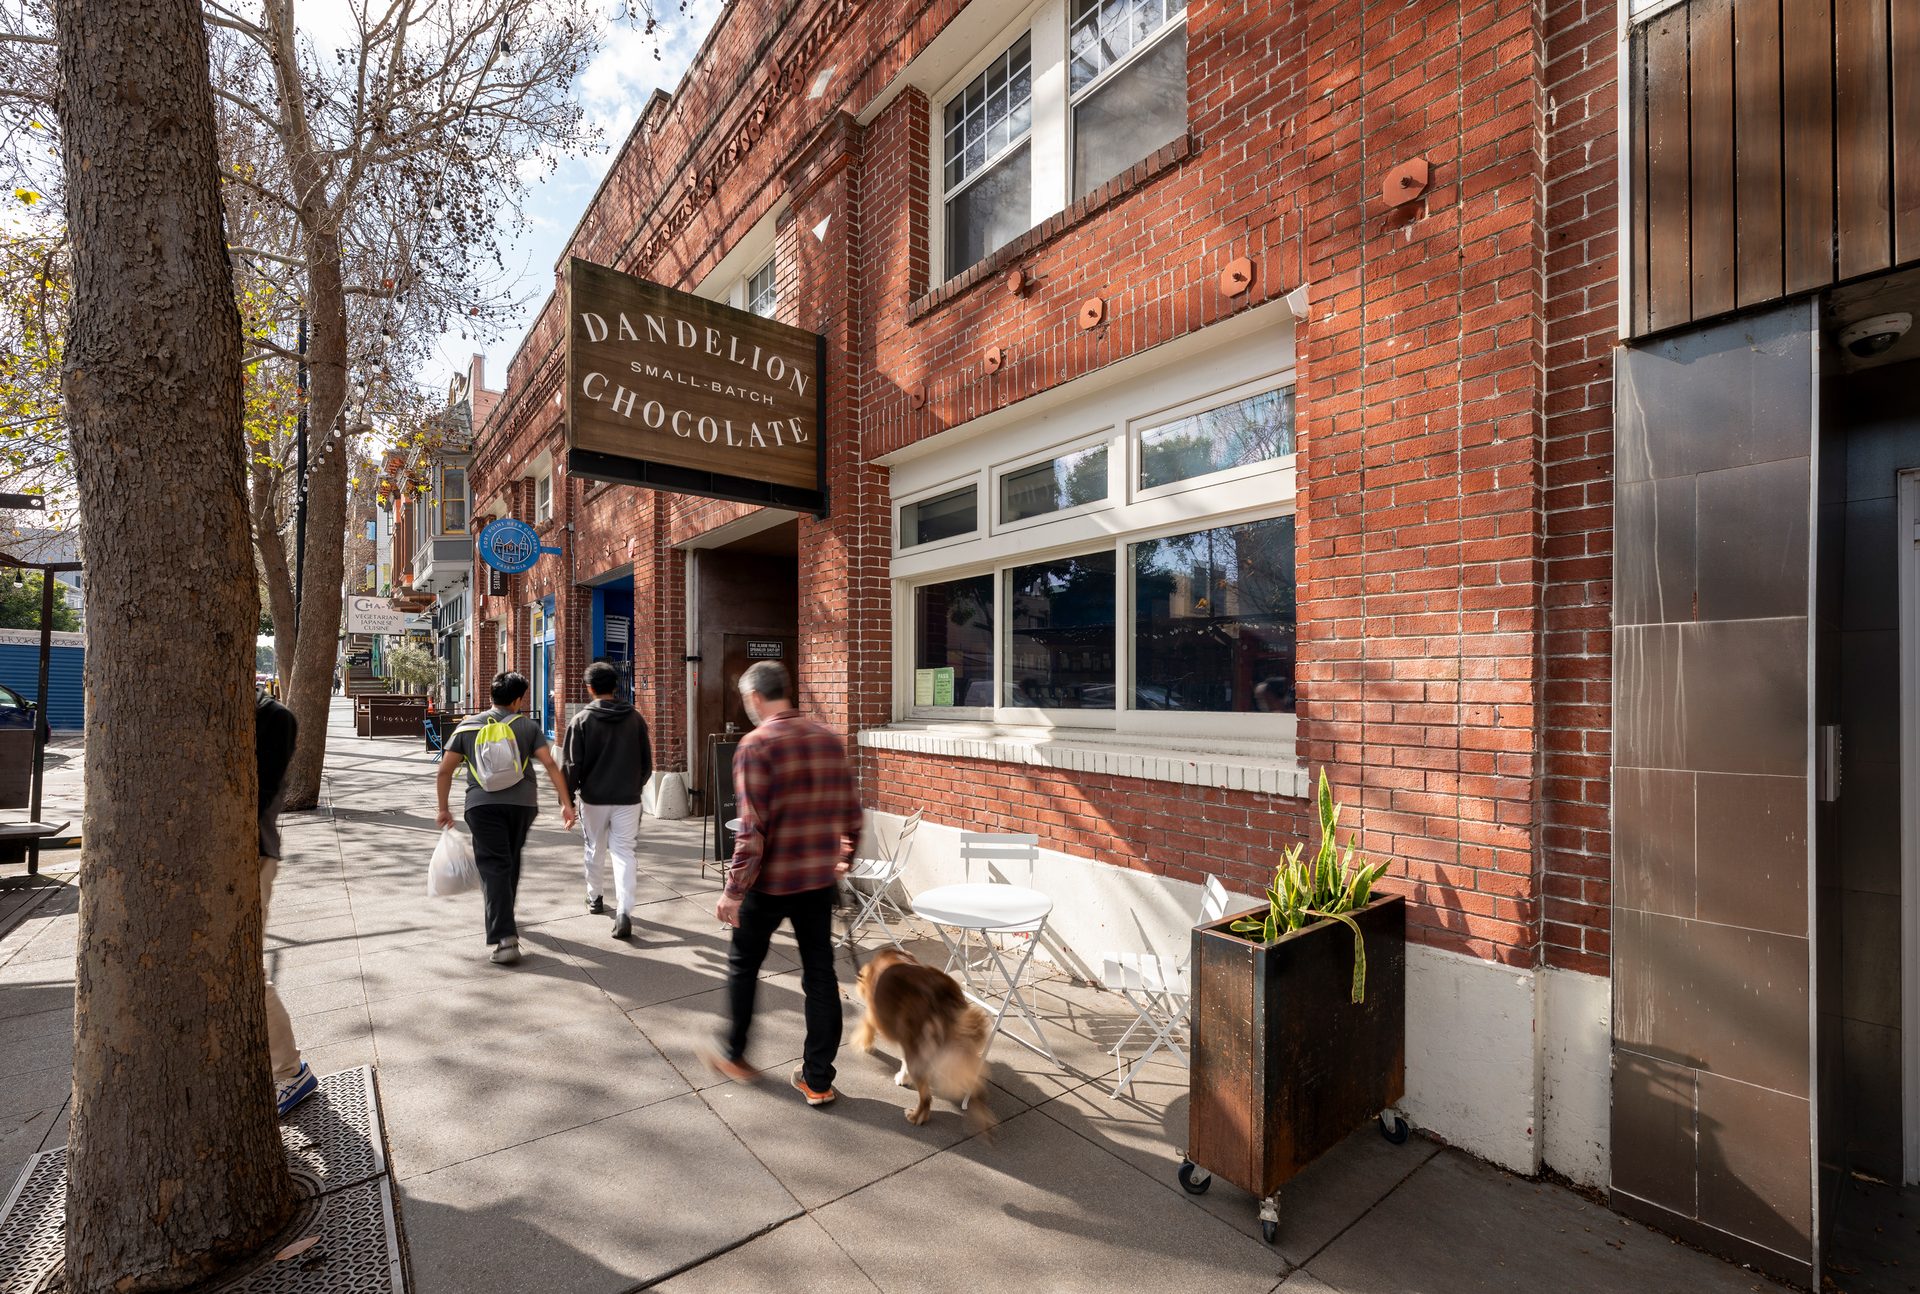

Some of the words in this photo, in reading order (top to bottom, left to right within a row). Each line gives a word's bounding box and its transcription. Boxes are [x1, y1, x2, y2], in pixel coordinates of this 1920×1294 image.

[580, 311, 811, 397] DANDELION
[630, 361, 773, 405] SMALL-BATCH
[582, 372, 809, 448] CHOCOLATE
[488, 521, 505, 532] POINT
[523, 527, 538, 554] COMPANY
[493, 570, 501, 590] WOLVES
[496, 562, 527, 570] VALENCIA
[354, 598, 394, 612] CHA-Y
